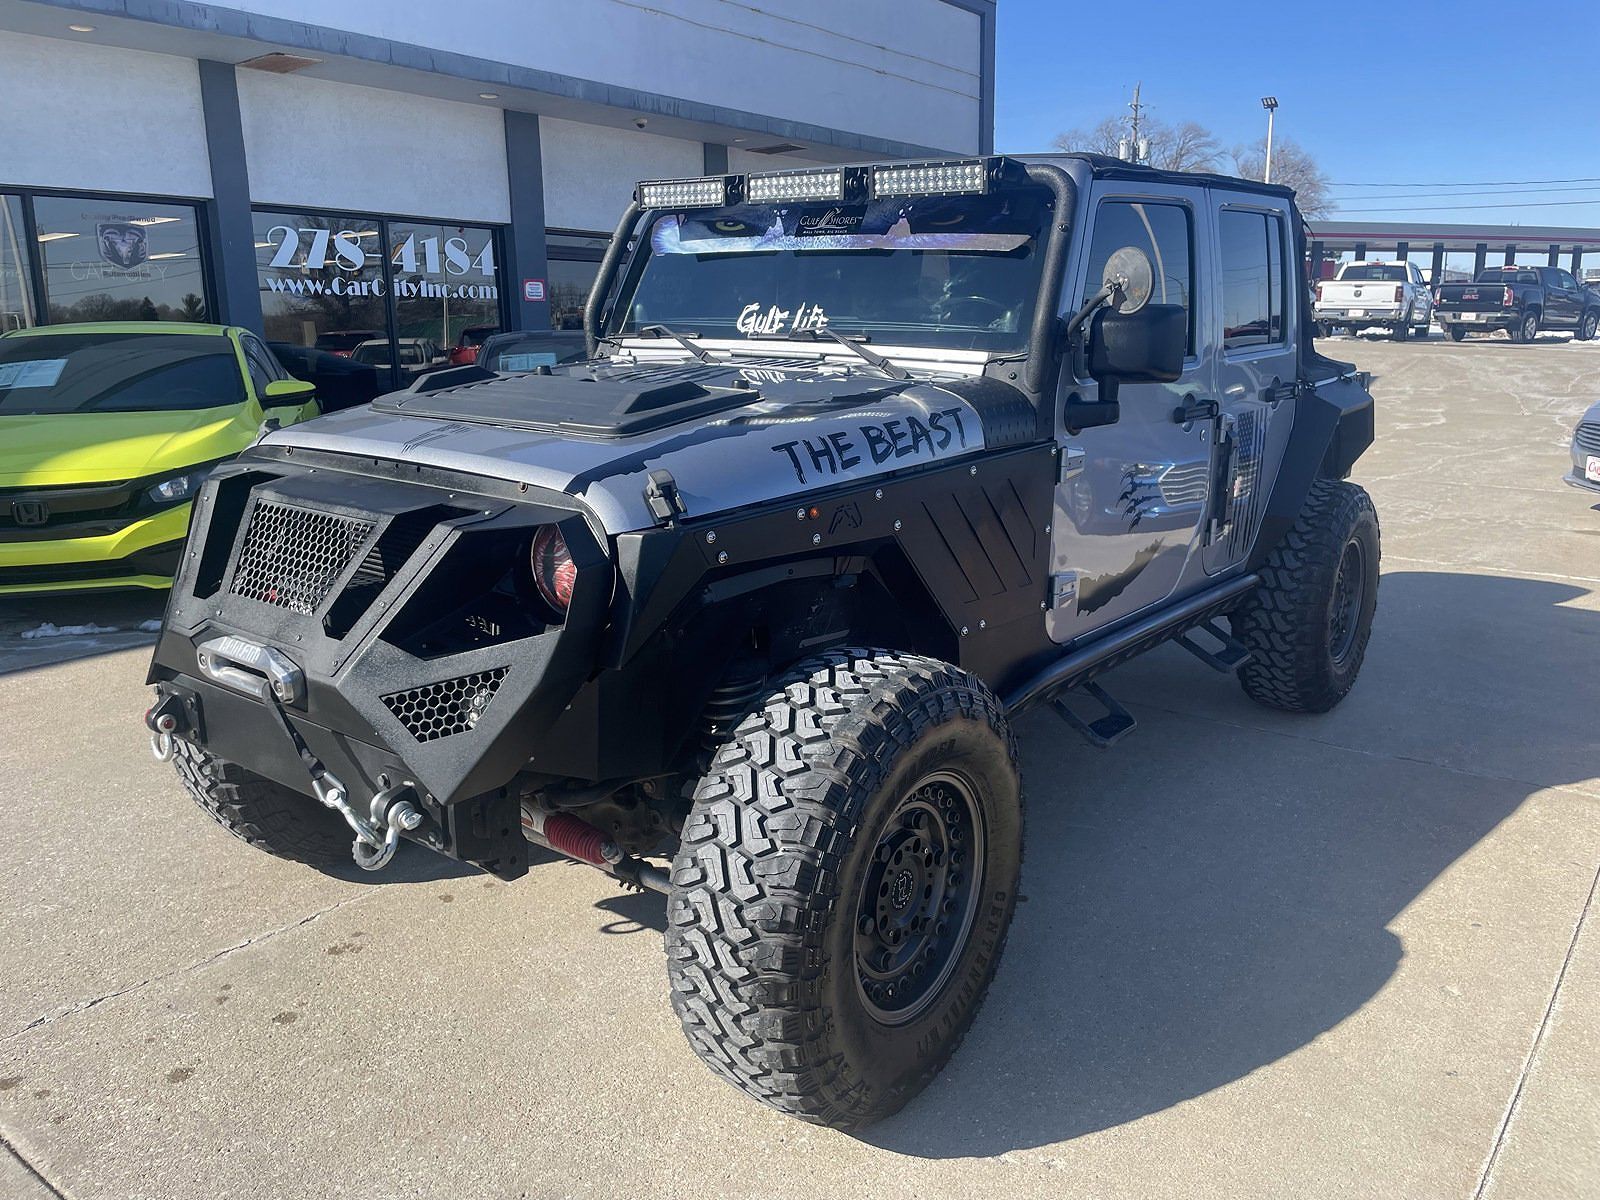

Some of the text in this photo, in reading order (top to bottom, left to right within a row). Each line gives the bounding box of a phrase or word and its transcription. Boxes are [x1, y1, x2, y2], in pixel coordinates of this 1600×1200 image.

[267, 225, 498, 277] 278-4184
[771, 408, 967, 485] THE BEAST
